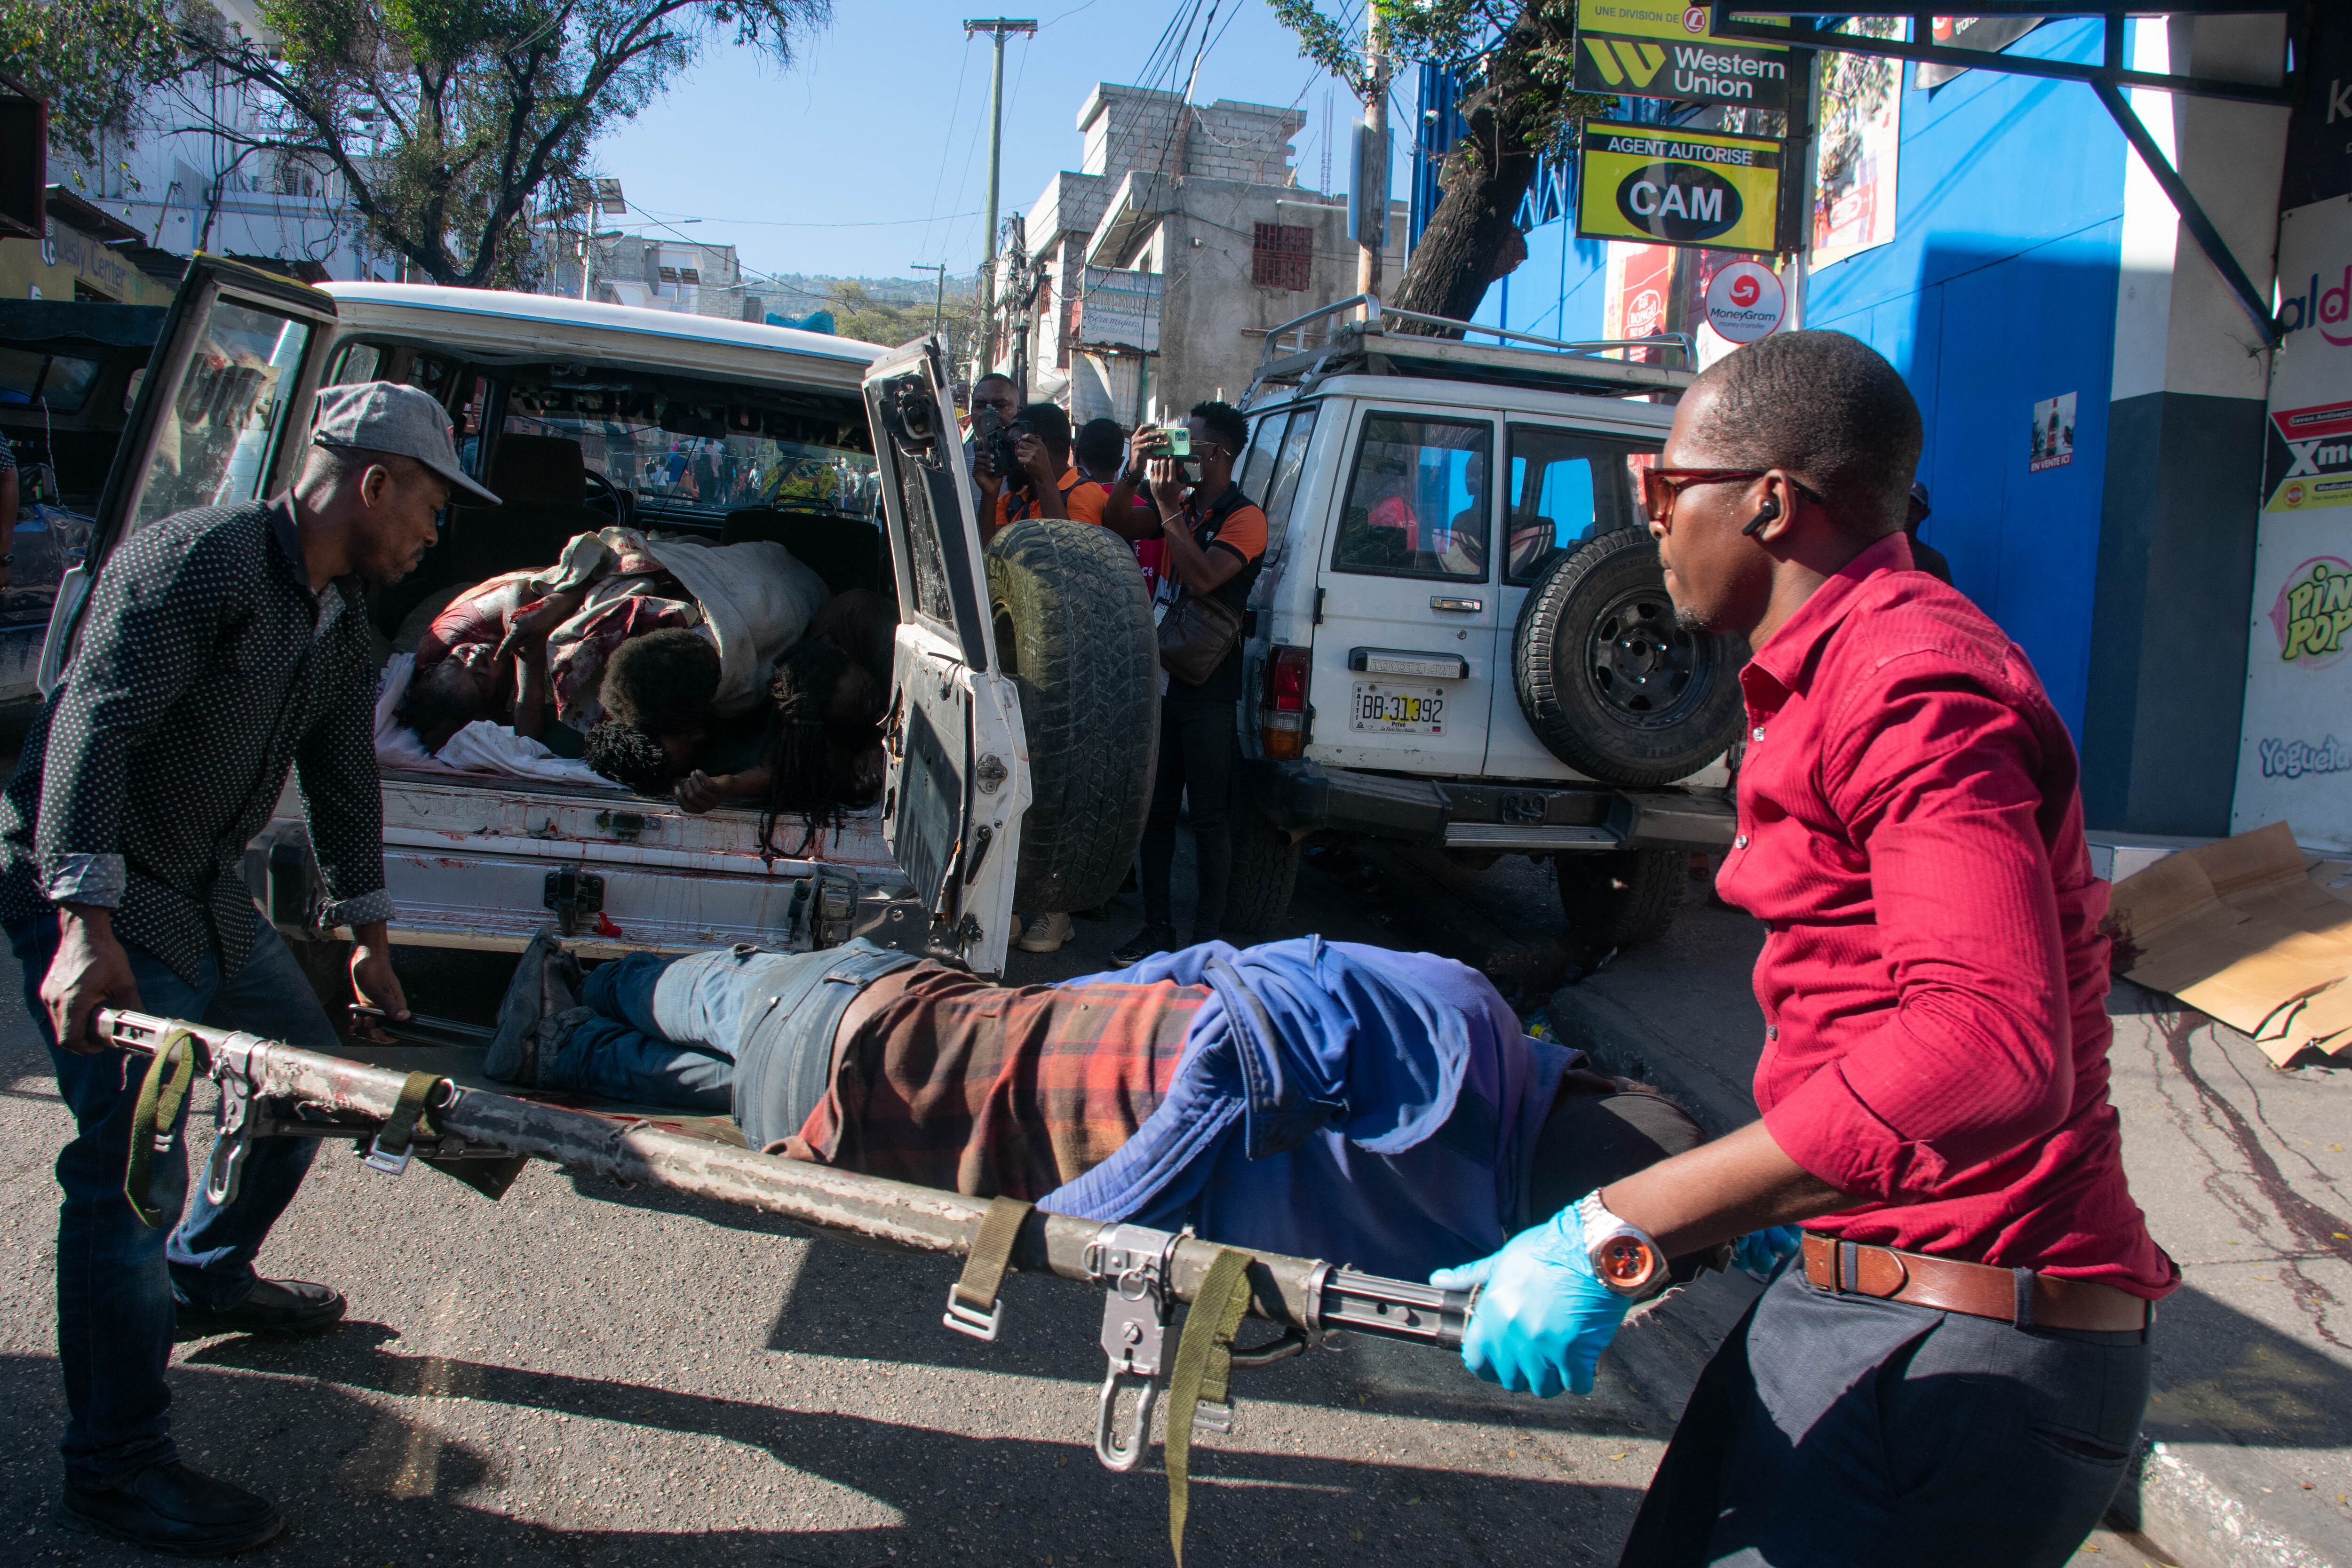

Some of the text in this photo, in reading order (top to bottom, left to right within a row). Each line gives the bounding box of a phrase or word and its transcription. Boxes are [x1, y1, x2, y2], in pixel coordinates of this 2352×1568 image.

[1595, 6, 1680, 24] UNE DIVISION DE
[1674, 46, 1785, 80] Western
[1674, 69, 1753, 99] Union
[1607, 136, 1753, 165] AGENT AUTORISE
[1629, 180, 1723, 222] CAM
[91, 241, 126, 289] Center
[1086, 311, 1139, 328] Céramiques
[1710, 308, 1776, 321] MoneyGram
[2031, 455, 2070, 471] EN VENTE ICI
[1156, 602, 1169, 612] PRESS
[1373, 661, 1458, 677] TOYOTA 4WD
[1362, 695, 1443, 723] BB-31392
